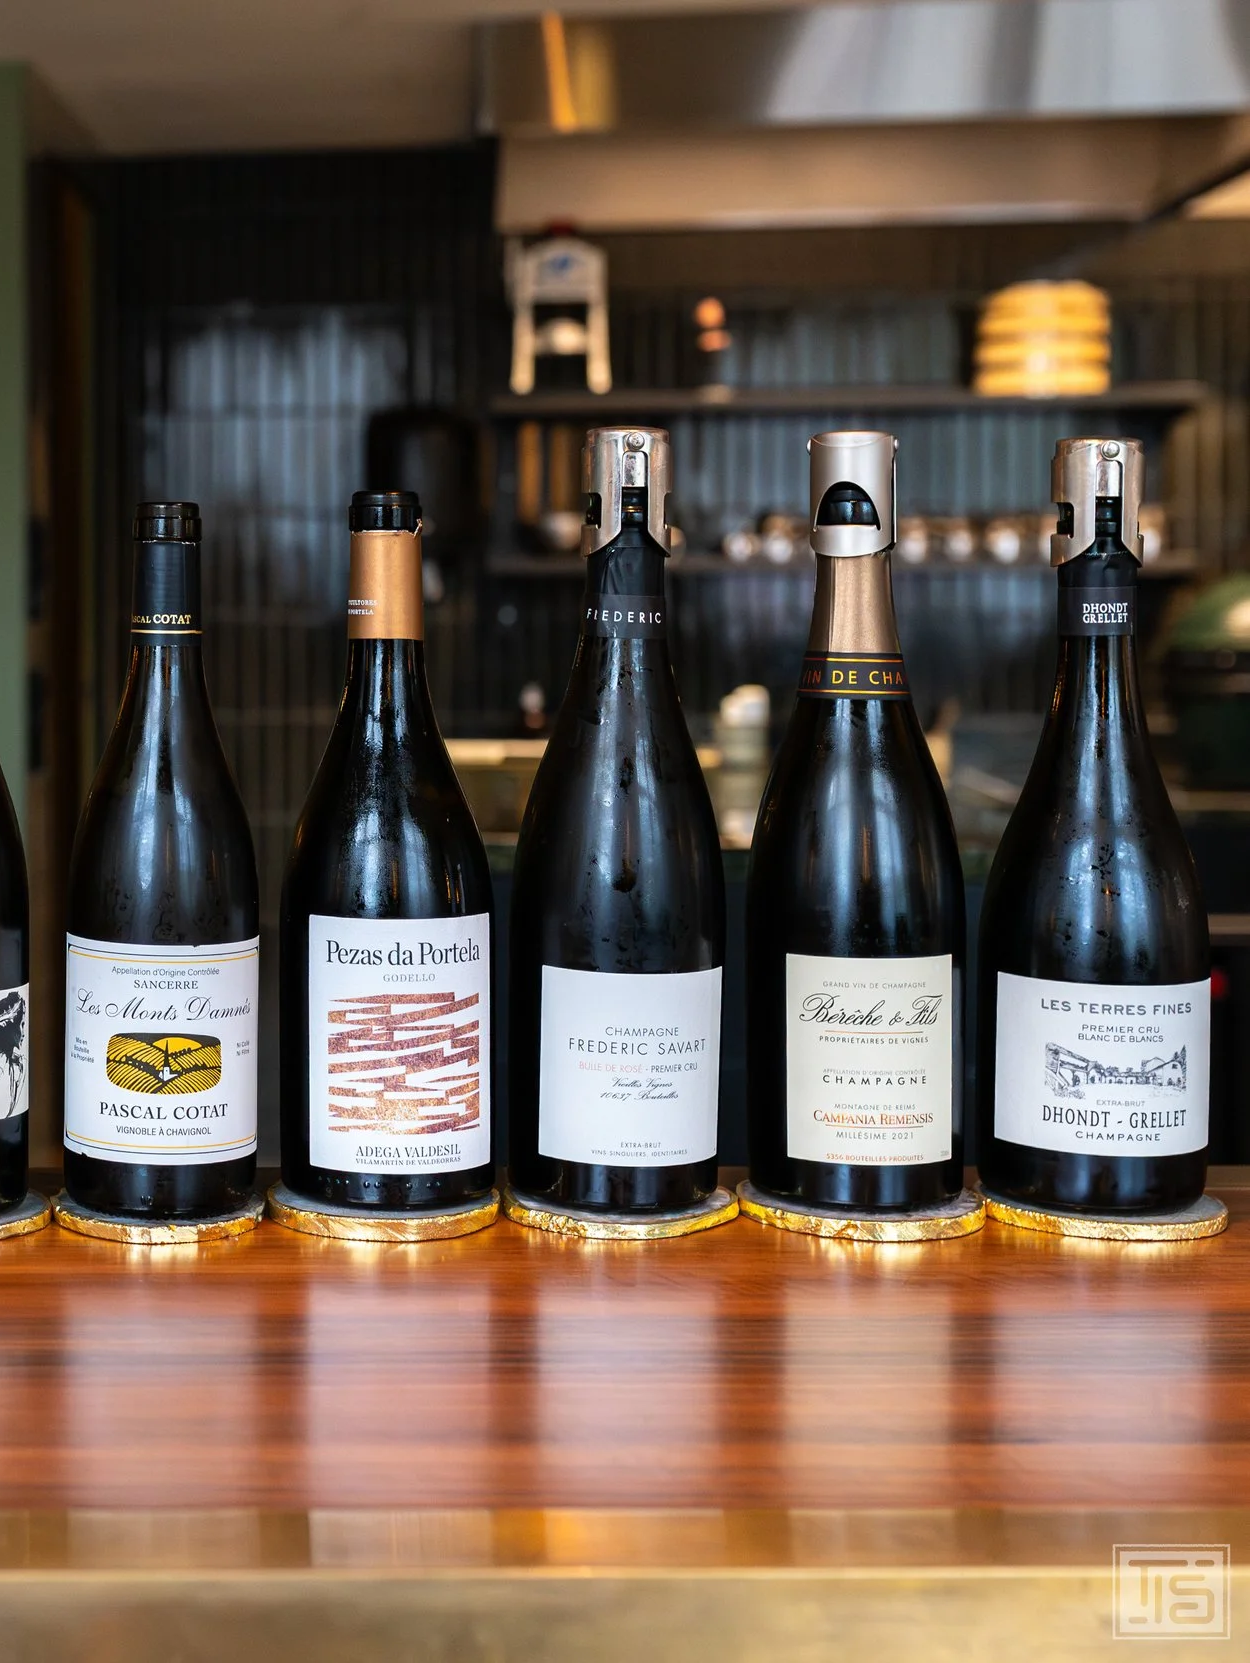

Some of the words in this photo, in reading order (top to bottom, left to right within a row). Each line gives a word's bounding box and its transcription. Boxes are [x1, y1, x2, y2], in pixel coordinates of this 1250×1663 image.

[1083, 603, 1128, 613] DHONDT
[153, 614, 191, 624] COTAT
[1083, 613, 1128, 623] GRELLET
[832, 670, 857, 684] DE
[326, 940, 382, 965] Pezas
[388, 943, 413, 966] da
[418, 938, 479, 966] Portela
[112, 966, 151, 976] Appellation
[153, 968, 186, 976] d'Origine
[188, 967, 219, 976] Contrôlée
[383, 974, 435, 982] GODELLO
[134, 980, 198, 989] SANCERRE
[76, 988, 100, 1015] Les
[105, 997, 178, 1021] Monts
[184, 996, 250, 1021] Damnés
[799, 993, 885, 1026] Bérêche
[889, 1011, 904, 1026] &
[906, 994, 943, 1026] Fils
[1042, 998, 1071, 1012] LES
[1078, 1003, 1146, 1016] TERRES
[1153, 1002, 1192, 1015] FINES
[605, 1027, 679, 1036] CHAMPAGNE
[1082, 1025, 1134, 1033] PREMIER
[1138, 1026, 1160, 1034] CRU
[820, 1036, 884, 1044] PROPRIÉTAIRES
[902, 1036, 929, 1044] VIGNES
[1078, 1034, 1110, 1042] BLANC
[1129, 1035, 1163, 1043] BLANCS
[569, 1038, 648, 1055] FREDERIC
[658, 1039, 705, 1055] SAVART
[579, 1061, 603, 1070] BULLE
[605, 1062, 617, 1070] DE
[620, 1062, 642, 1073] ROSÉ
[651, 1064, 682, 1073] PREMIER
[684, 1063, 697, 1071] CRU
[646, 1078, 673, 1090] Vignes
[823, 1075, 926, 1086] CHAMPAGNE
[100, 1102, 167, 1119] PASCAL
[174, 1104, 228, 1120] COTAT
[814, 1110, 876, 1125] CAMPANIA
[880, 1113, 933, 1125] REMENSIS
[1043, 1105, 1110, 1128] DHONDT
[1129, 1109, 1186, 1129] GRELLET
[117, 1126, 156, 1136] VIGNOBLE
[159, 1126, 164, 1136] À
[166, 1126, 211, 1136] CHAVIGNOL
[836, 1130, 887, 1140] MILLÉSIME
[892, 1132, 914, 1140] 2021
[1076, 1131, 1161, 1142] CHAMPAGNE
[356, 1145, 401, 1157] ADEGA
[405, 1144, 461, 1157] VALDESIL
[418, 1157, 461, 1166] VALDEORRAS
[846, 1154, 887, 1162] BOUTEILLES
